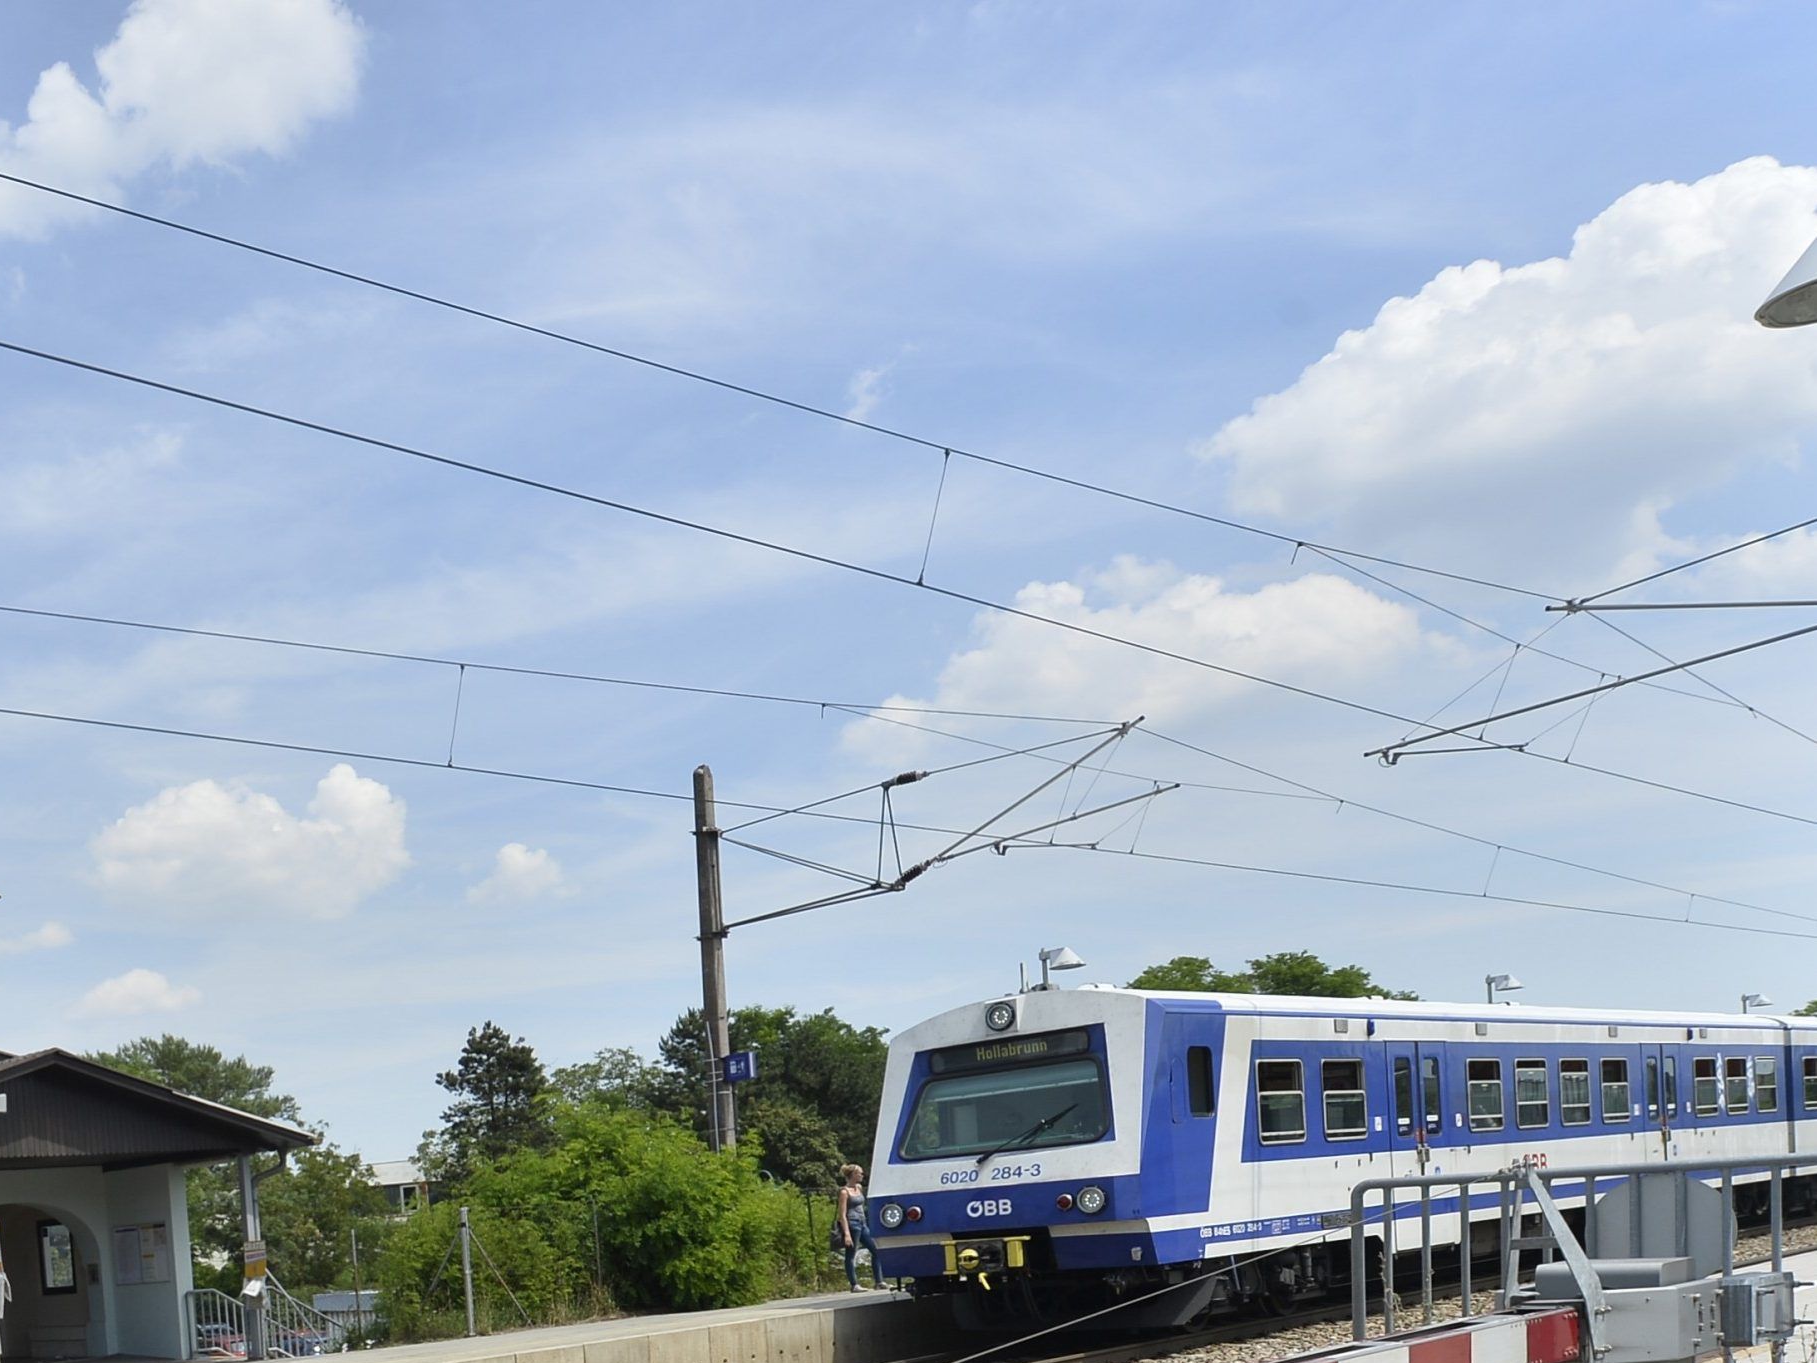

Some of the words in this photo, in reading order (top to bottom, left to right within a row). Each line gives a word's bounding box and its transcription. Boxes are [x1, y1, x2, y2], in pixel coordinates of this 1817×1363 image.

[976, 1040, 1048, 1061] Hollabrunn
[940, 1169, 979, 1185] 6020
[991, 1163, 1041, 1181] 284-3
[966, 1198, 1012, 1218] ÖBB
